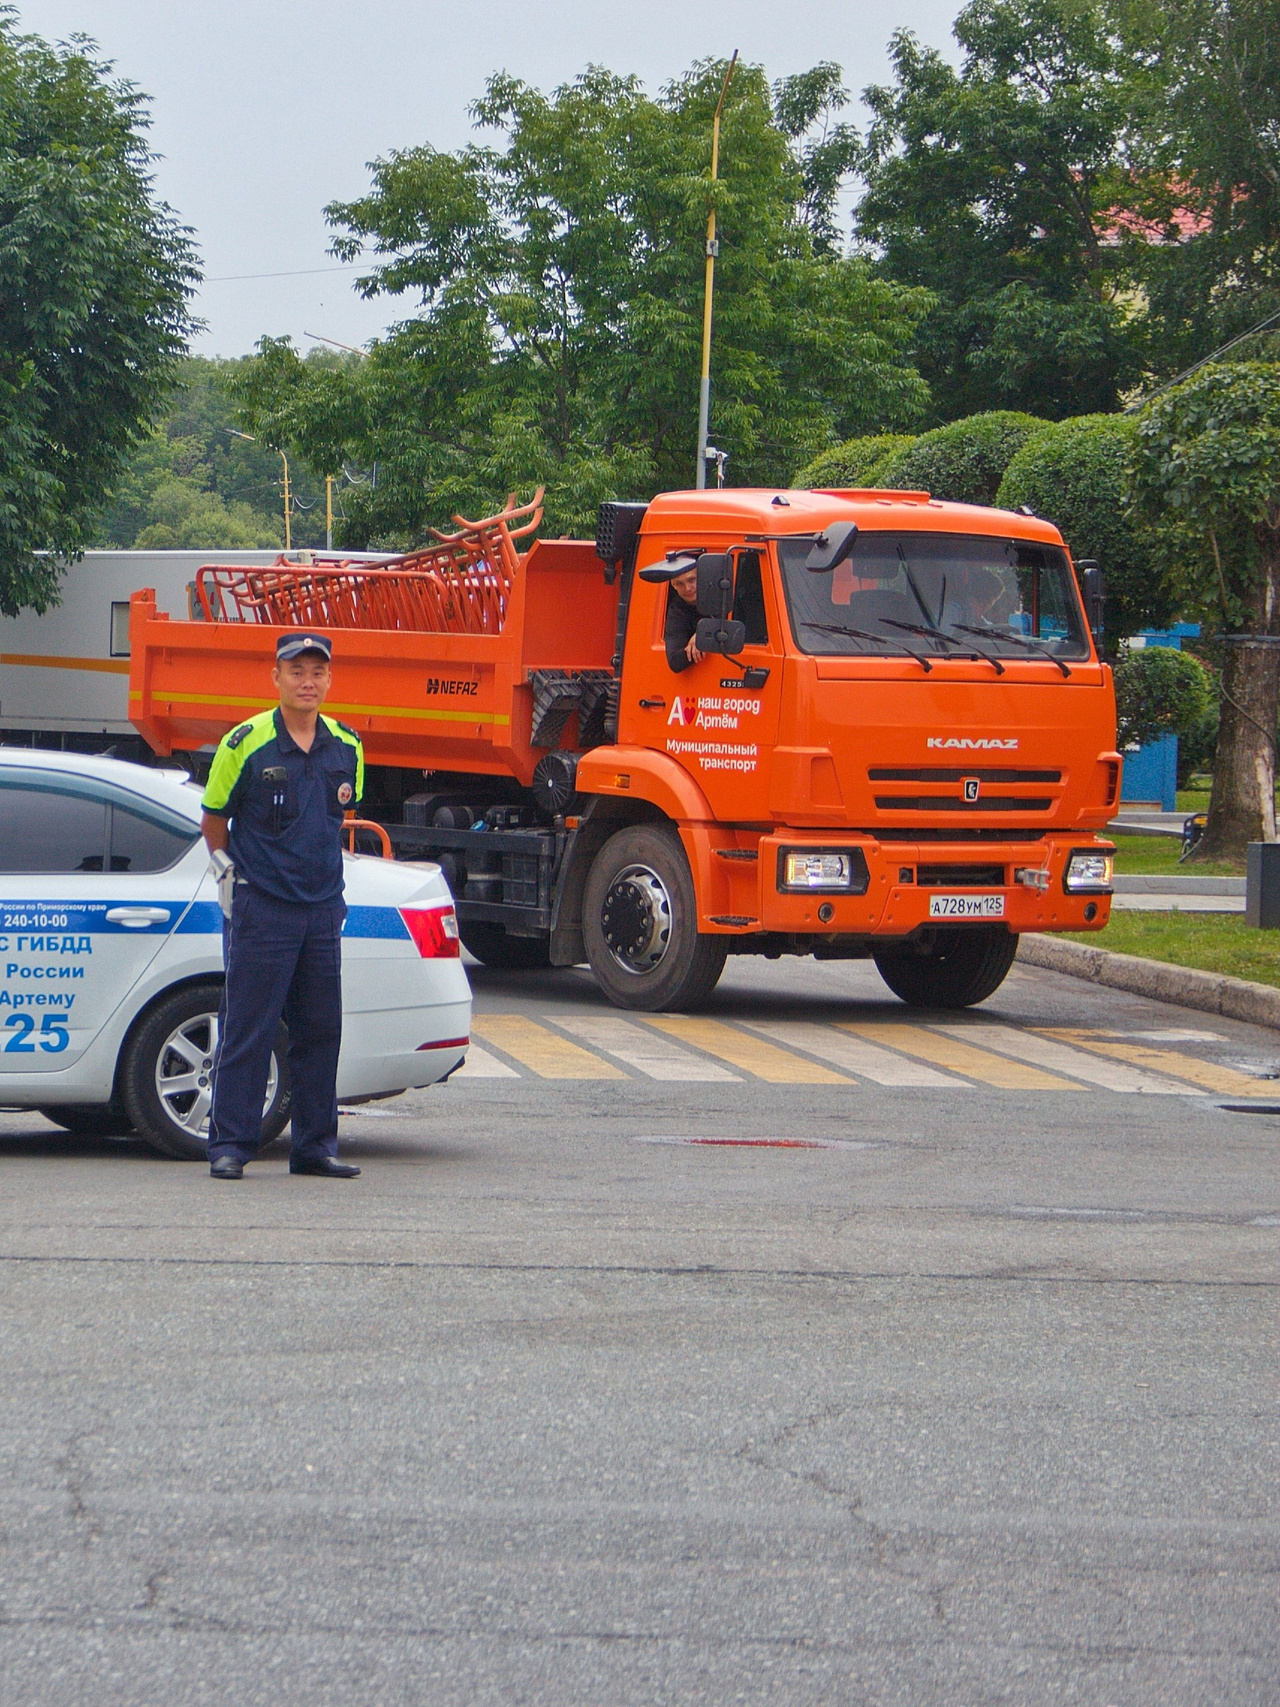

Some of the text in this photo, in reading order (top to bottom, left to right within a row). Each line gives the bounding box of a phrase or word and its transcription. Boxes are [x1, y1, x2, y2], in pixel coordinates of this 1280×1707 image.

[440, 680, 478, 695] NEFAZ
[721, 680, 745, 688] 4325
[697, 697, 760, 714] наш город
[695, 711, 738, 730] Артём
[666, 739, 757, 756] Муниципальный
[926, 737, 1018, 749] KAMAZ
[699, 757, 757, 773] транспорт
[0, 903, 25, 911] России
[37, 903, 87, 912] Приморскому
[984, 897, 1002, 910] 125
[4, 914, 68, 928] 240-10-00
[17, 936, 93, 955] ГИБДД
[6, 963, 85, 979] России
